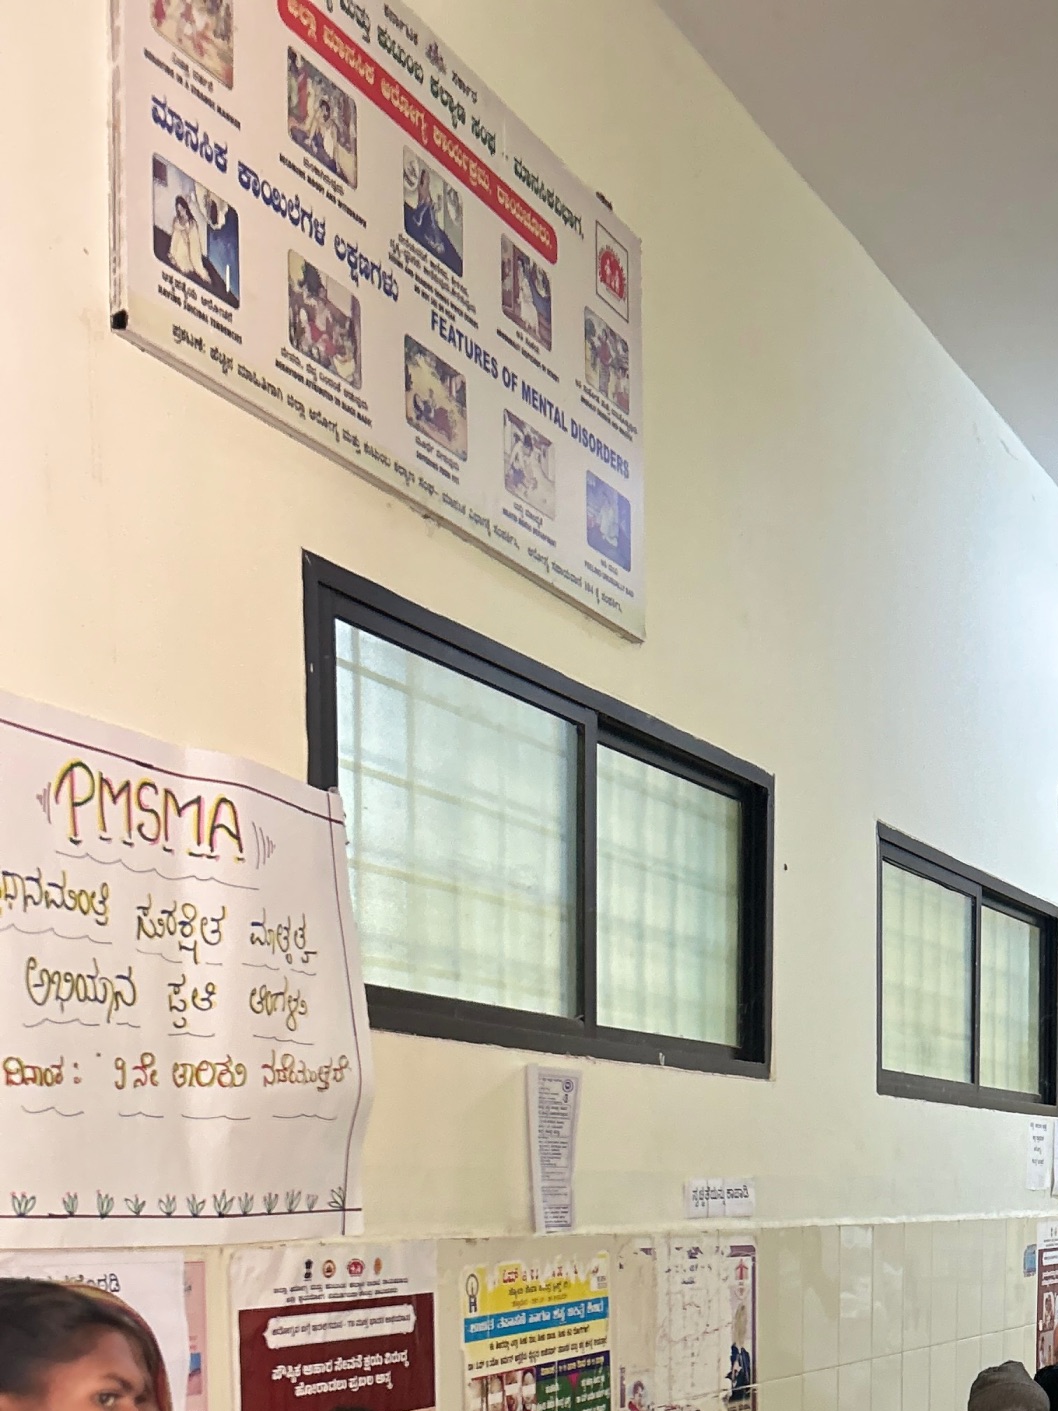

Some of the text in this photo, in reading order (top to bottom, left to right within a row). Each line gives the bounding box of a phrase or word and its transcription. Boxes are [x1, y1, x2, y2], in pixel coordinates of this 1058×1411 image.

[151, 96, 227, 173] ಮಾನಸಿಕ
[238, 161, 325, 245] ಕಾಯಿಲೆಗಳ
[334, 235, 398, 301] ಲಕ್ಷಣಗಳು
[431, 309, 498, 378] FEATURES
[501, 365, 517, 392] OF
[521, 380, 567, 432] MENTAL
[570, 418, 628, 478] DISORDERS
[55, 760, 245, 862] PMSMA
